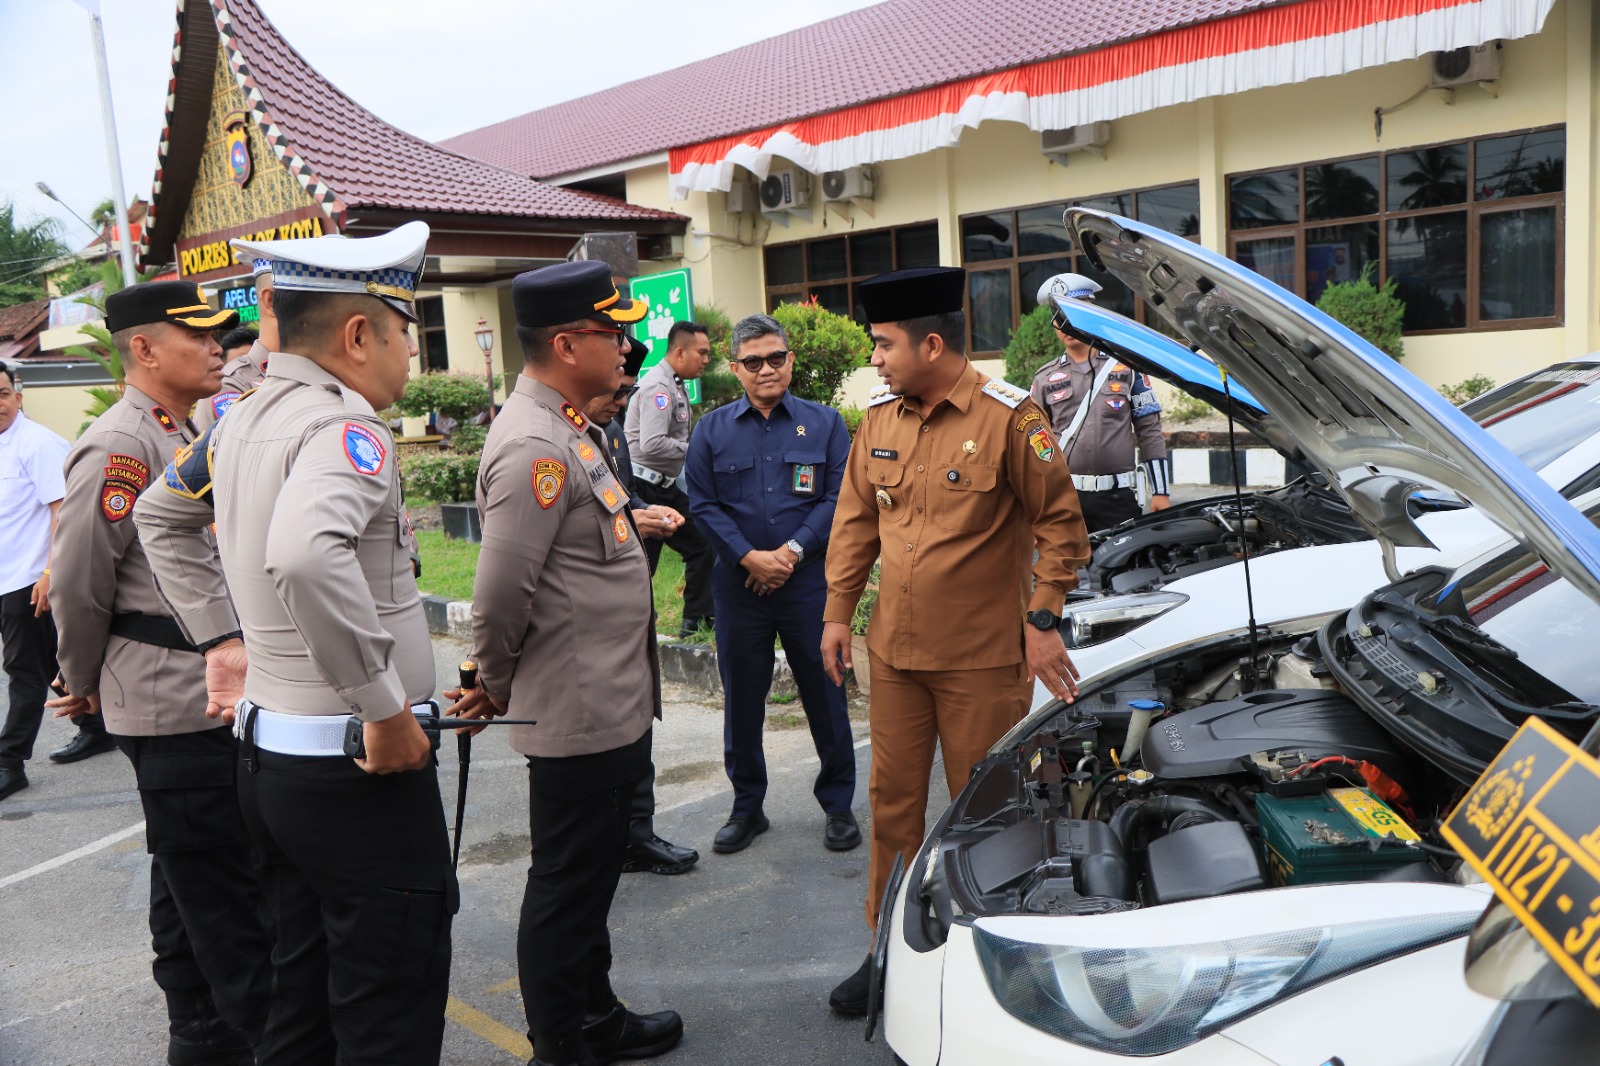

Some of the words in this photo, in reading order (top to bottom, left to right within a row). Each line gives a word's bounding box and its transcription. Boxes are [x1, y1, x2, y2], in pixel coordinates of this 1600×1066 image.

[181, 240, 229, 276] POLRES
[279, 217, 323, 241] KOTA
[224, 288, 249, 308] APEL
[239, 305, 261, 323] PATU
[1371, 810, 1399, 826] GS
[1494, 824, 1573, 914] 1121
